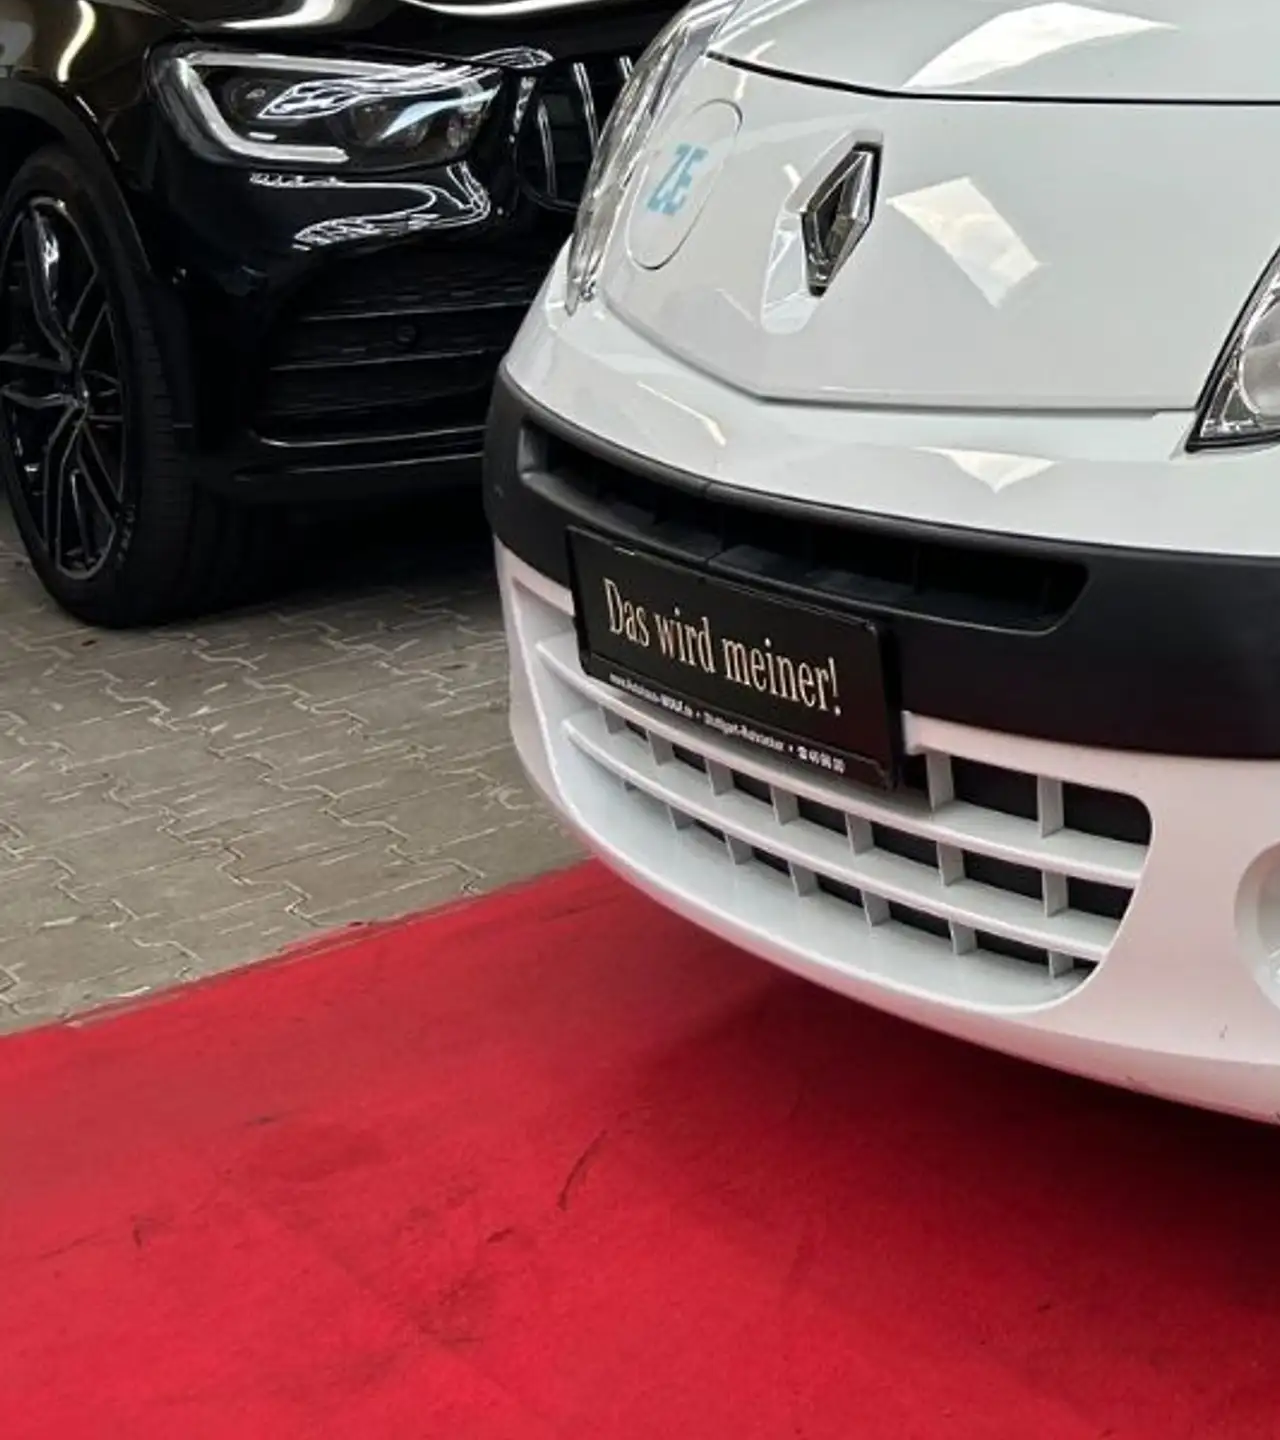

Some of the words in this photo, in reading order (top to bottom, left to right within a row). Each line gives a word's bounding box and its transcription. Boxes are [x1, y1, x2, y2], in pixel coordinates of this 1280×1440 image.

[603, 576, 651, 649] Das
[654, 607, 716, 675] wird
[722, 638, 843, 717] meiner!
